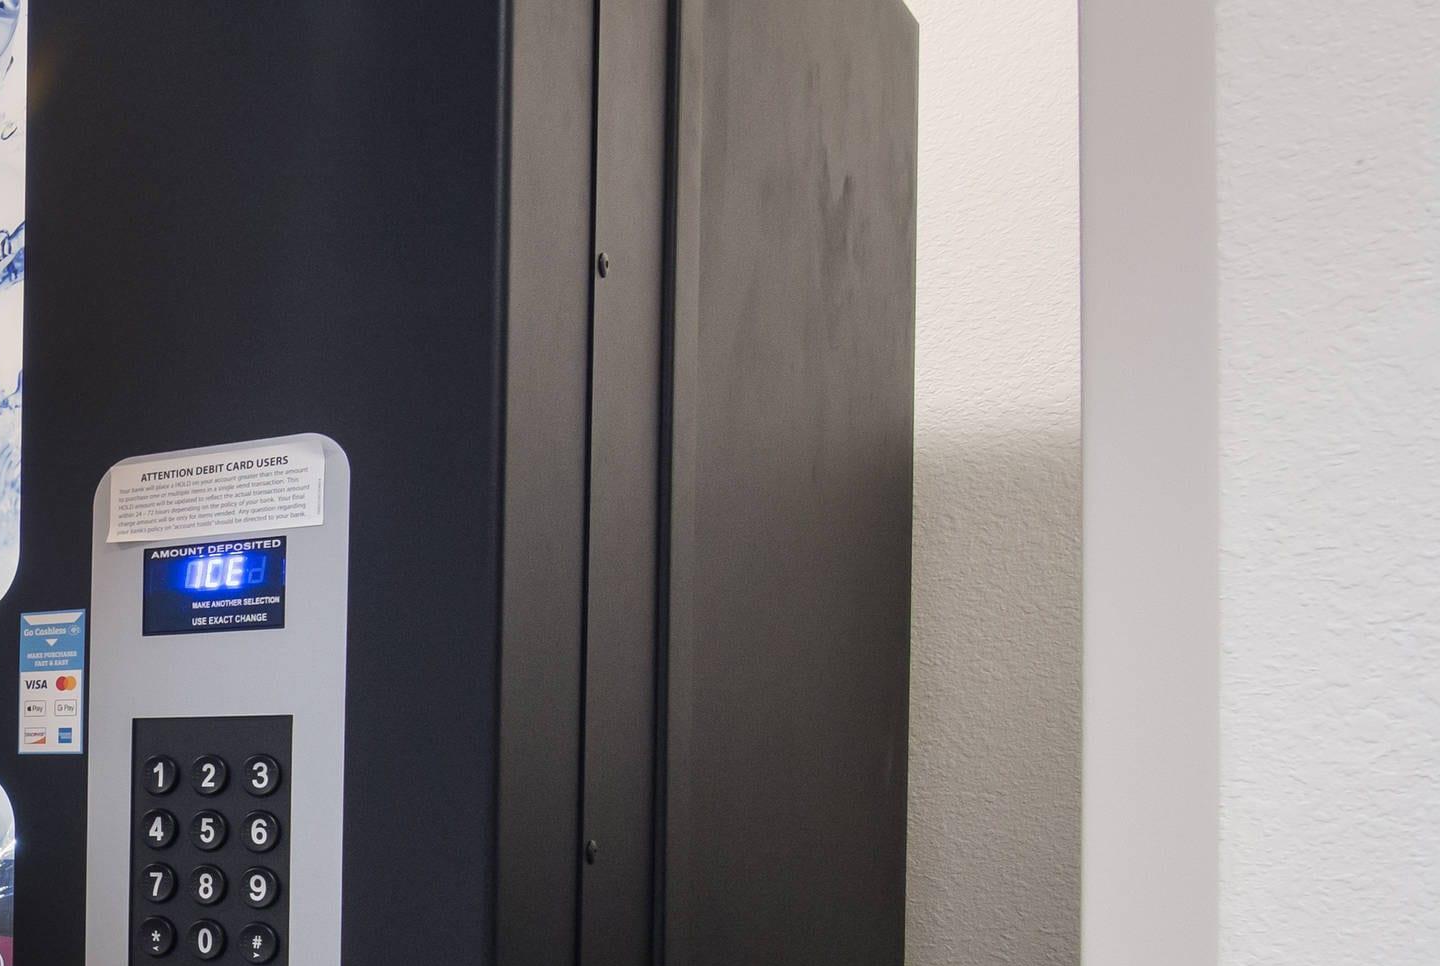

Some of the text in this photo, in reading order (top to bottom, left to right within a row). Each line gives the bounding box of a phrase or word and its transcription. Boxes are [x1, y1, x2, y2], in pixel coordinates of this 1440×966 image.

[141, 456, 289, 483] ATTENTION DEBIT CARD USERS
[151, 539, 281, 560] AMOUNT DEPOSITED
[192, 595, 280, 610] MAKE ANOTHER SELECTION
[192, 613, 268, 626] USE EXACT CHANGE
[24, 626, 67, 637] Go Cashless
[25, 680, 48, 690] VISA
[153, 762, 269, 788] 1 2 3
[149, 816, 267, 845] 4 5 6
[149, 872, 267, 901] 7 8 9
[198, 928, 213, 954] 0
